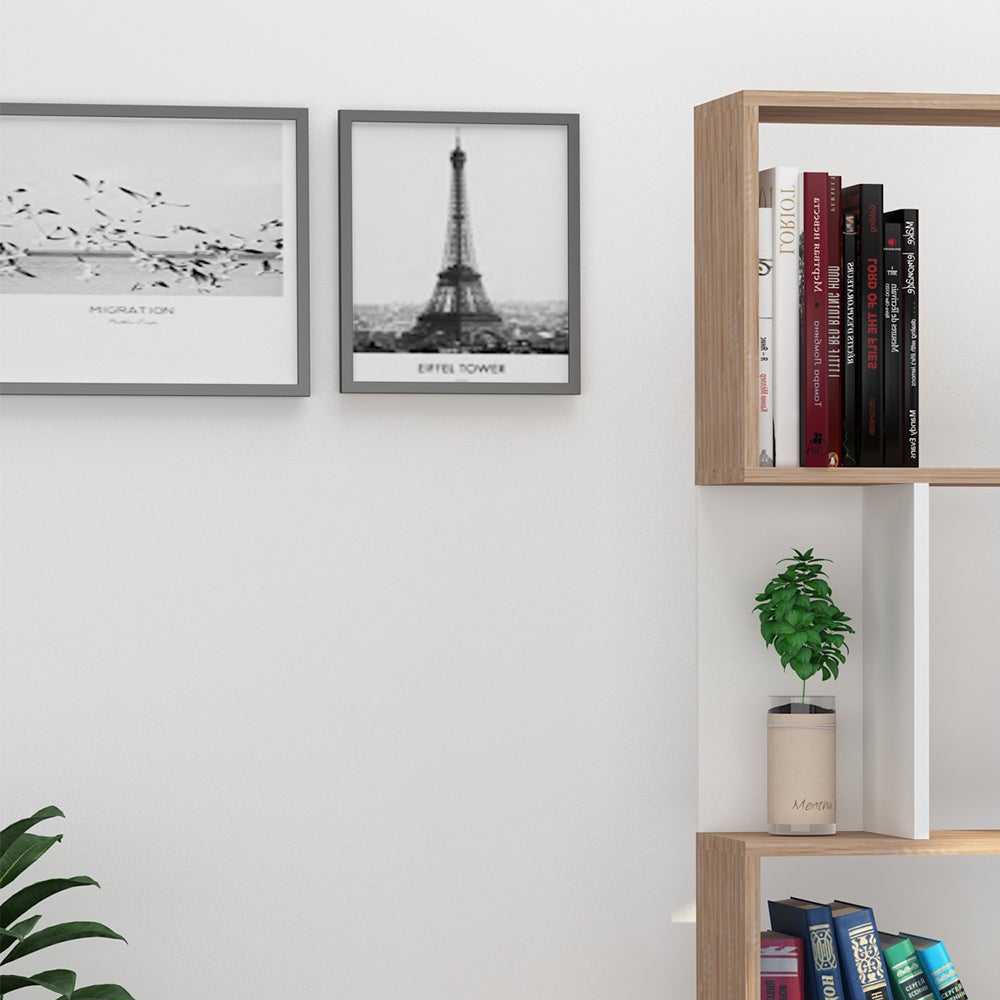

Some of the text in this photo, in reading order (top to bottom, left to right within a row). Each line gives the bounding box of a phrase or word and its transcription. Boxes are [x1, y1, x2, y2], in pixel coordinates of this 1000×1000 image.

[89, 306, 174, 314] MIGRATION
[418, 364, 505, 374] EIFFEL TOWER
